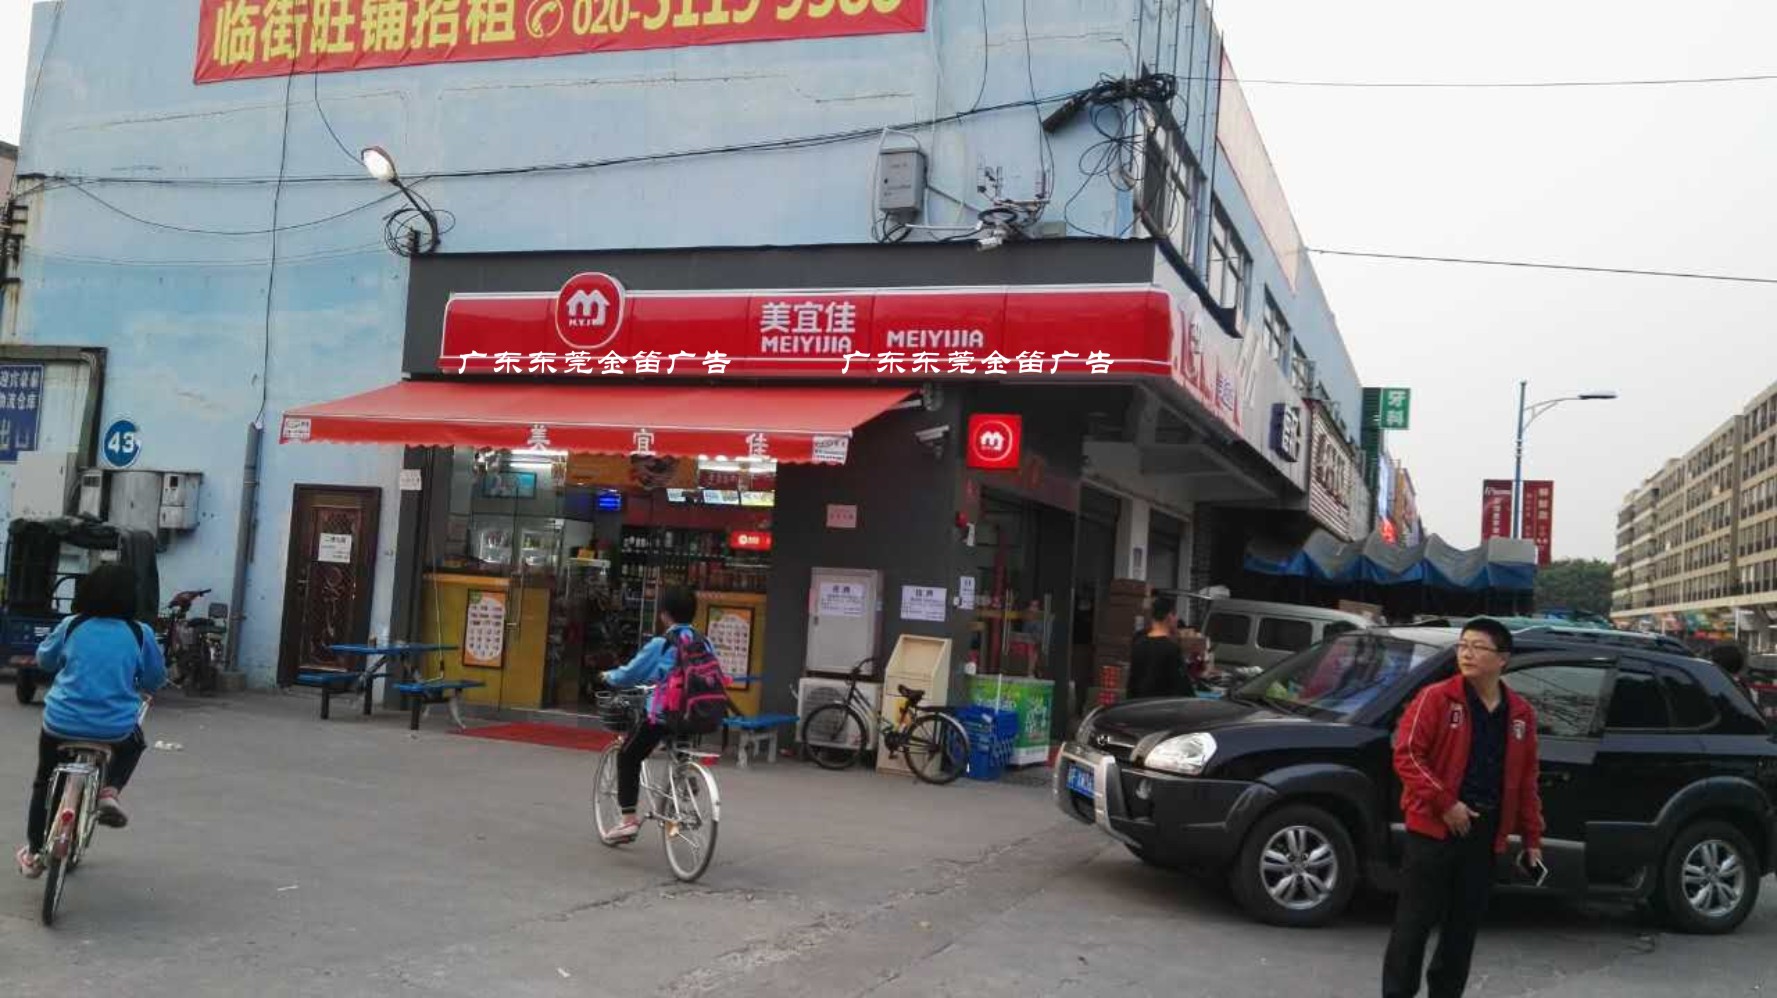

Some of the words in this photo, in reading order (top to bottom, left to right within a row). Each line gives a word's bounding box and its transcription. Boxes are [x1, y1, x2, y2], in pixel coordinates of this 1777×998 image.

[211, 0, 516, 66] 临街旺铺招租
[761, 300, 856, 333] 美宜佳
[761, 335, 852, 354] MEIYIJIA
[887, 329, 984, 348] MEIYIJIA
[1386, 390, 1406, 427] 牙科
[107, 431, 135, 454] 43
